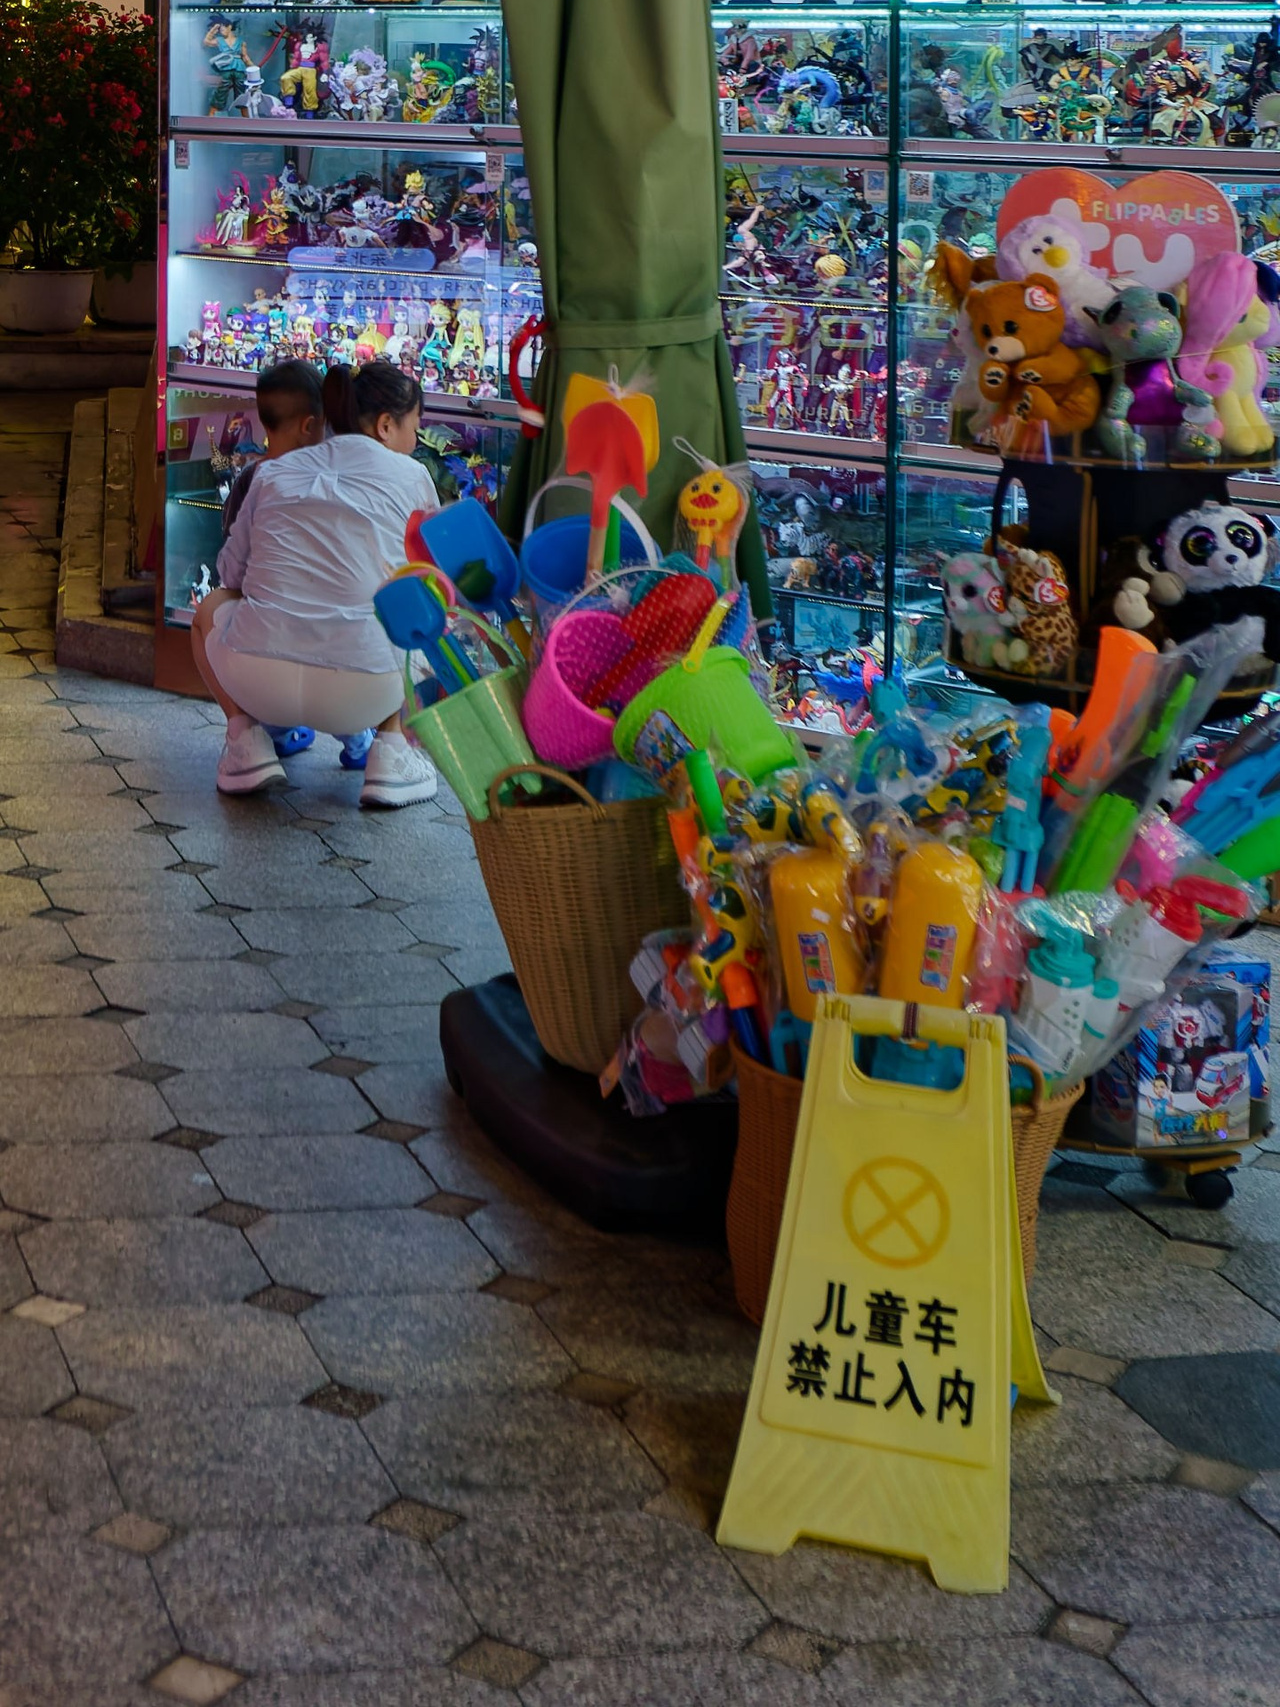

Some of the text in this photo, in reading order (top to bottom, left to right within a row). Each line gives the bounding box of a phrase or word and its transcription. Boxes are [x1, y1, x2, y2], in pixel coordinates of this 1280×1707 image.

[812, 1280, 960, 1356] 儿童车
[786, 1339, 977, 1429] 禁止入内
